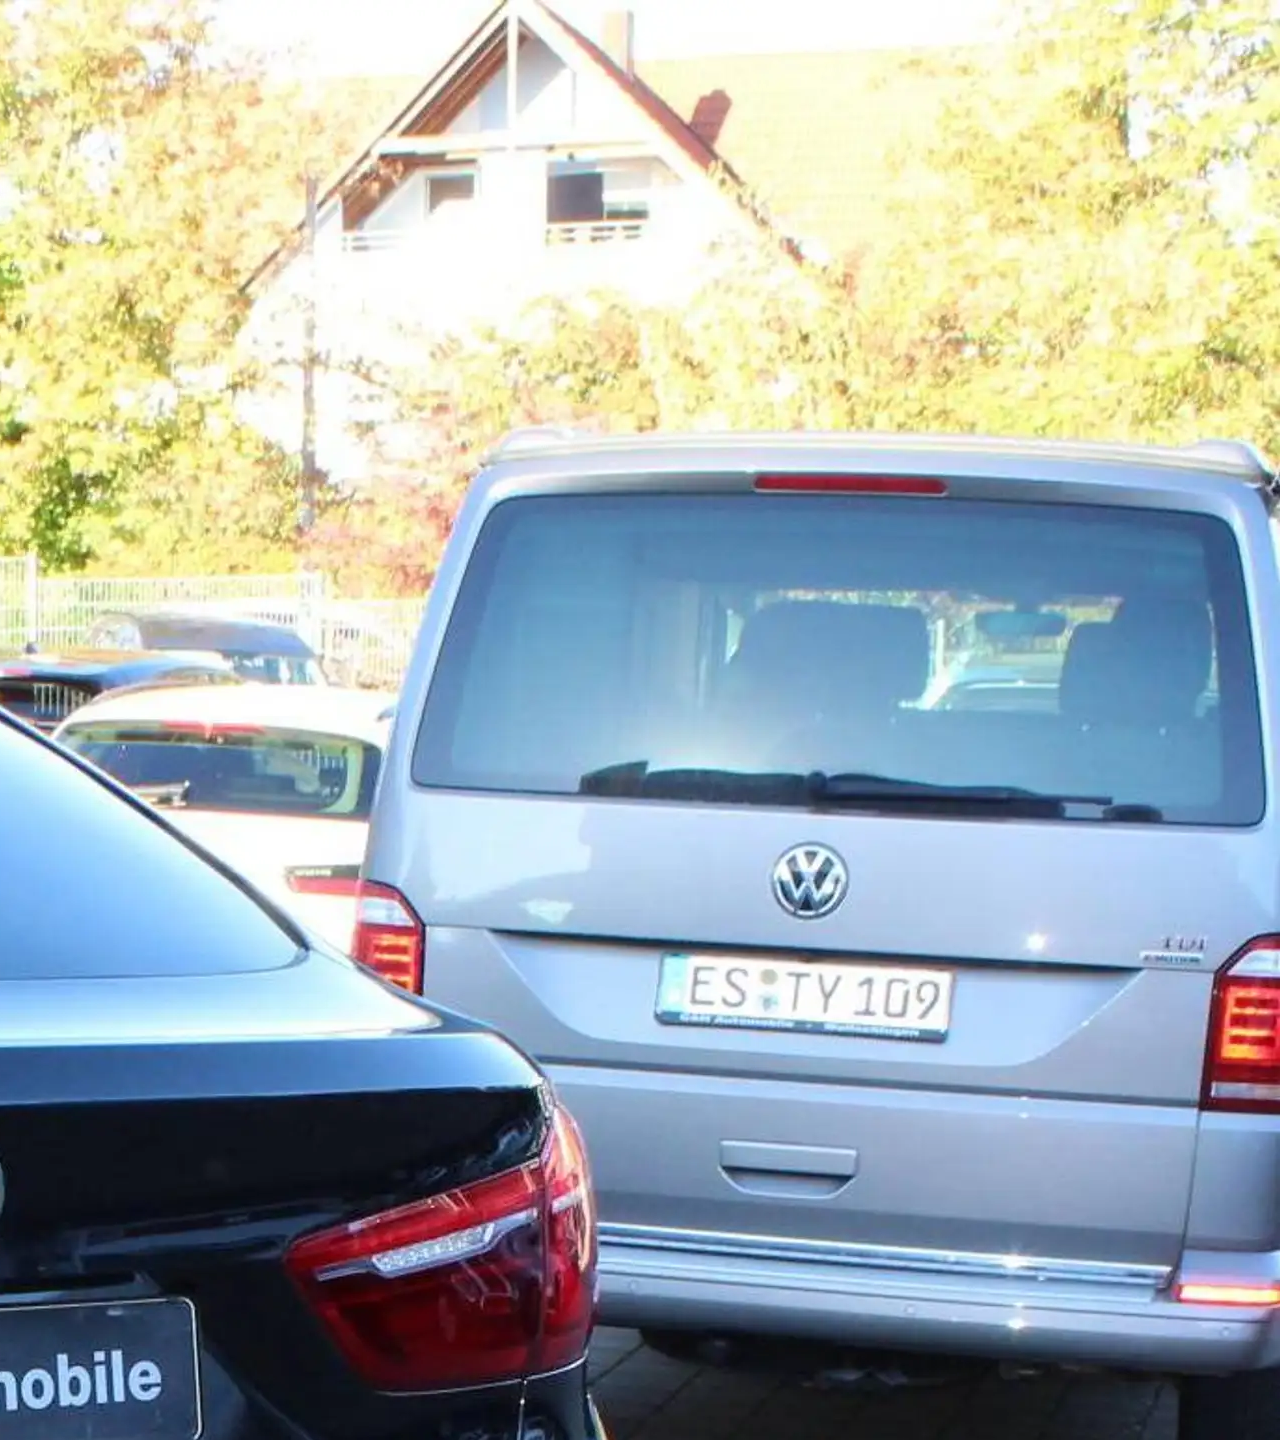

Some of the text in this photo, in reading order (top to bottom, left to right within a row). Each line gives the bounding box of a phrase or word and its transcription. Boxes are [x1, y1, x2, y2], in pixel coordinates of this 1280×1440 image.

[689, 966, 941, 1020] ES TY 109
